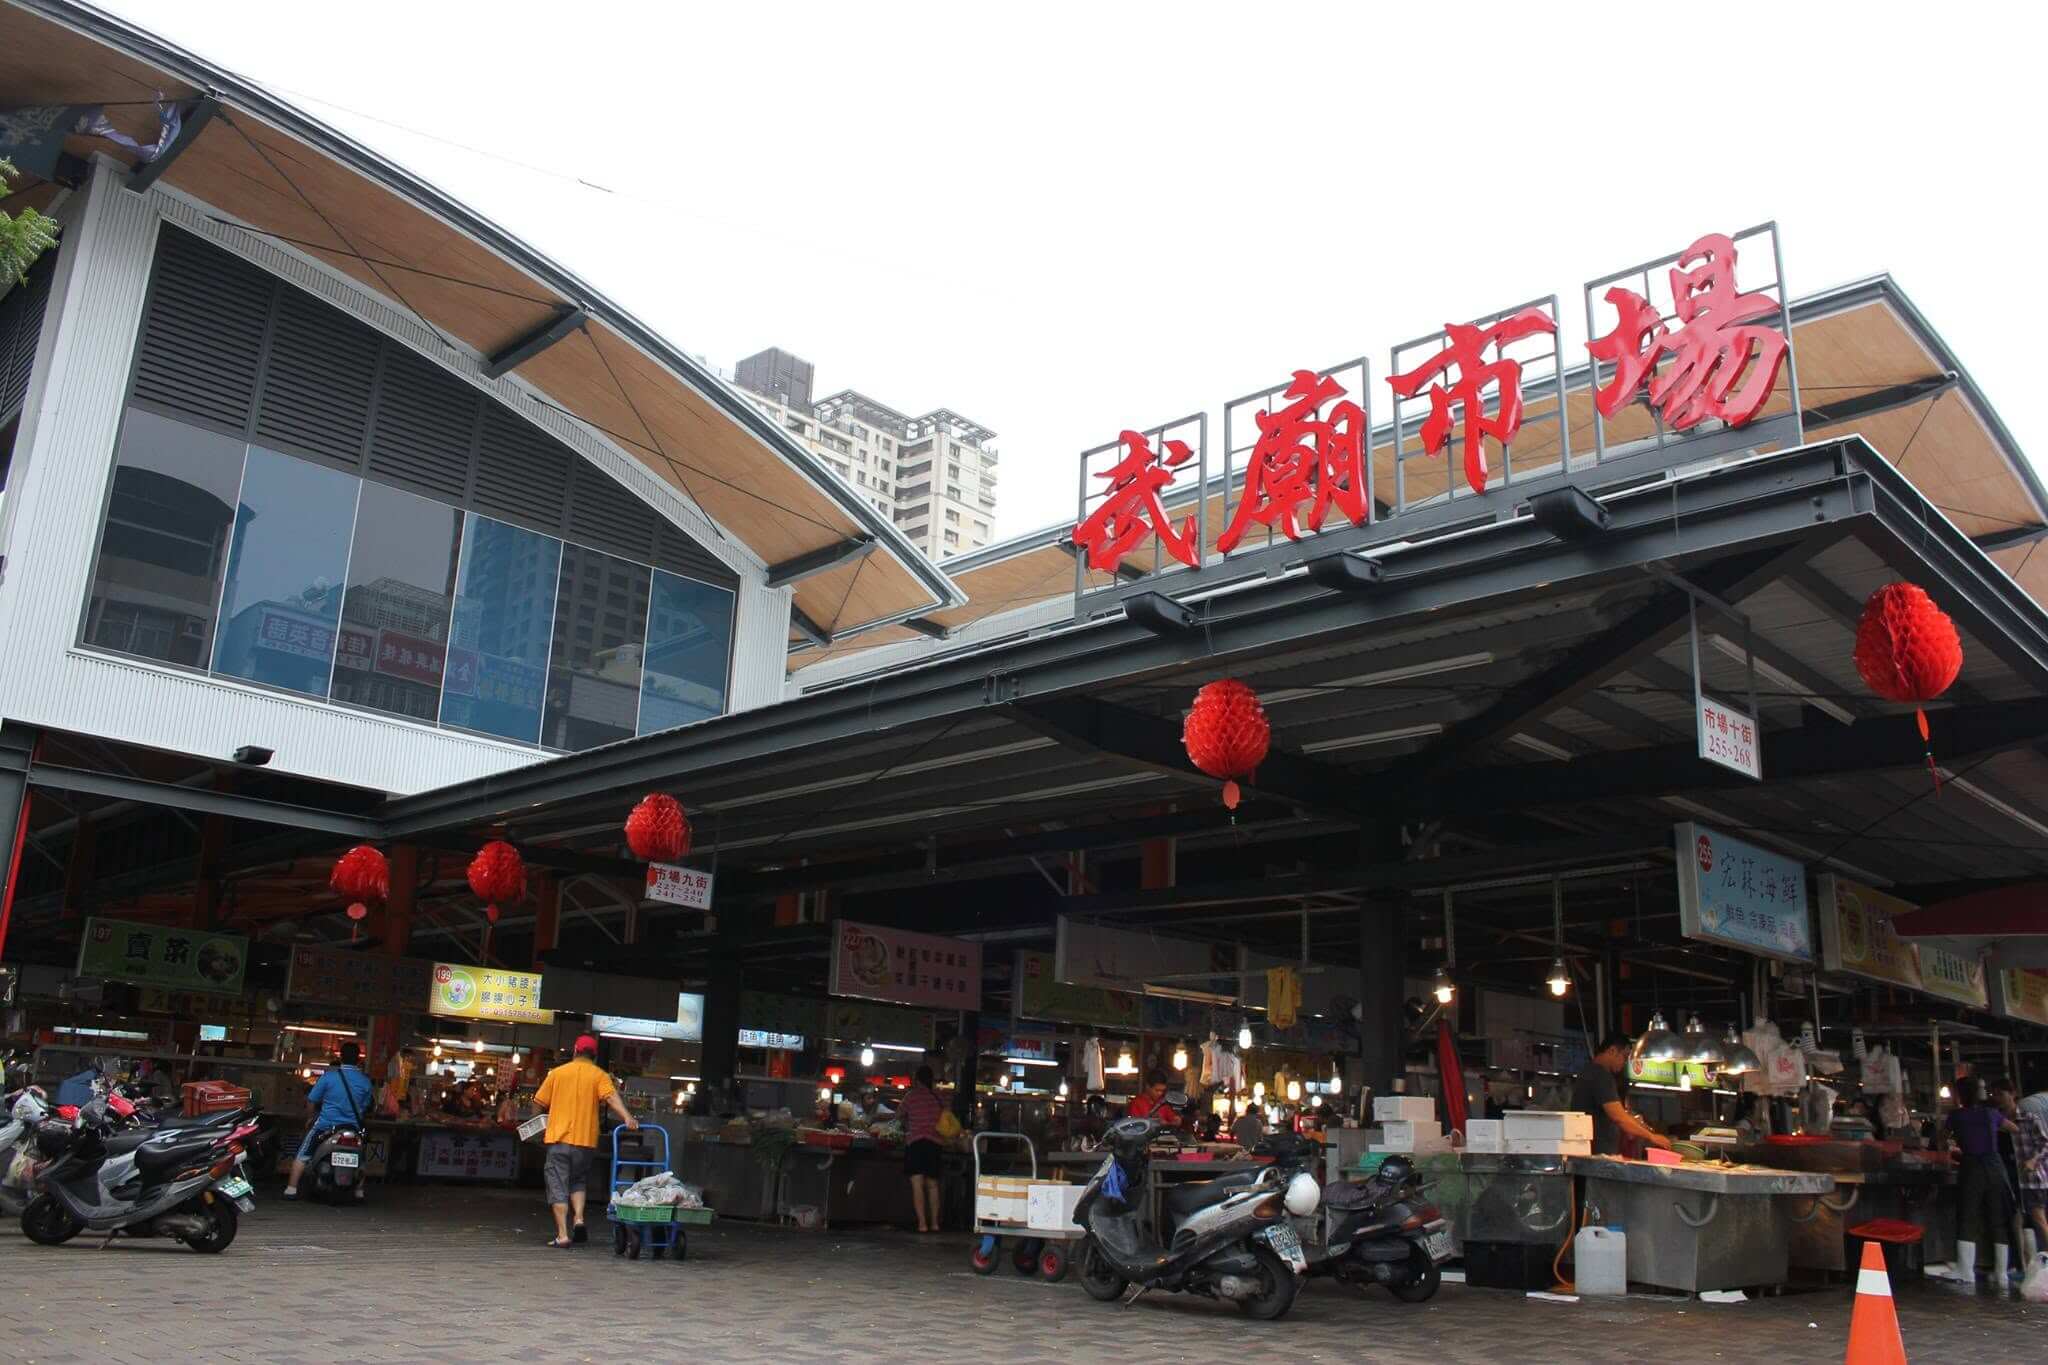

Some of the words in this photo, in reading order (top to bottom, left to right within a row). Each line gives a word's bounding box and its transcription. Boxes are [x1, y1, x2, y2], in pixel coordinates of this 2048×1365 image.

[1073, 233, 1789, 572] 武廟市場
[1704, 706, 1752, 746] 市場十街
[656, 866, 708, 889] 市場九街
[436, 968, 451, 981] 199
